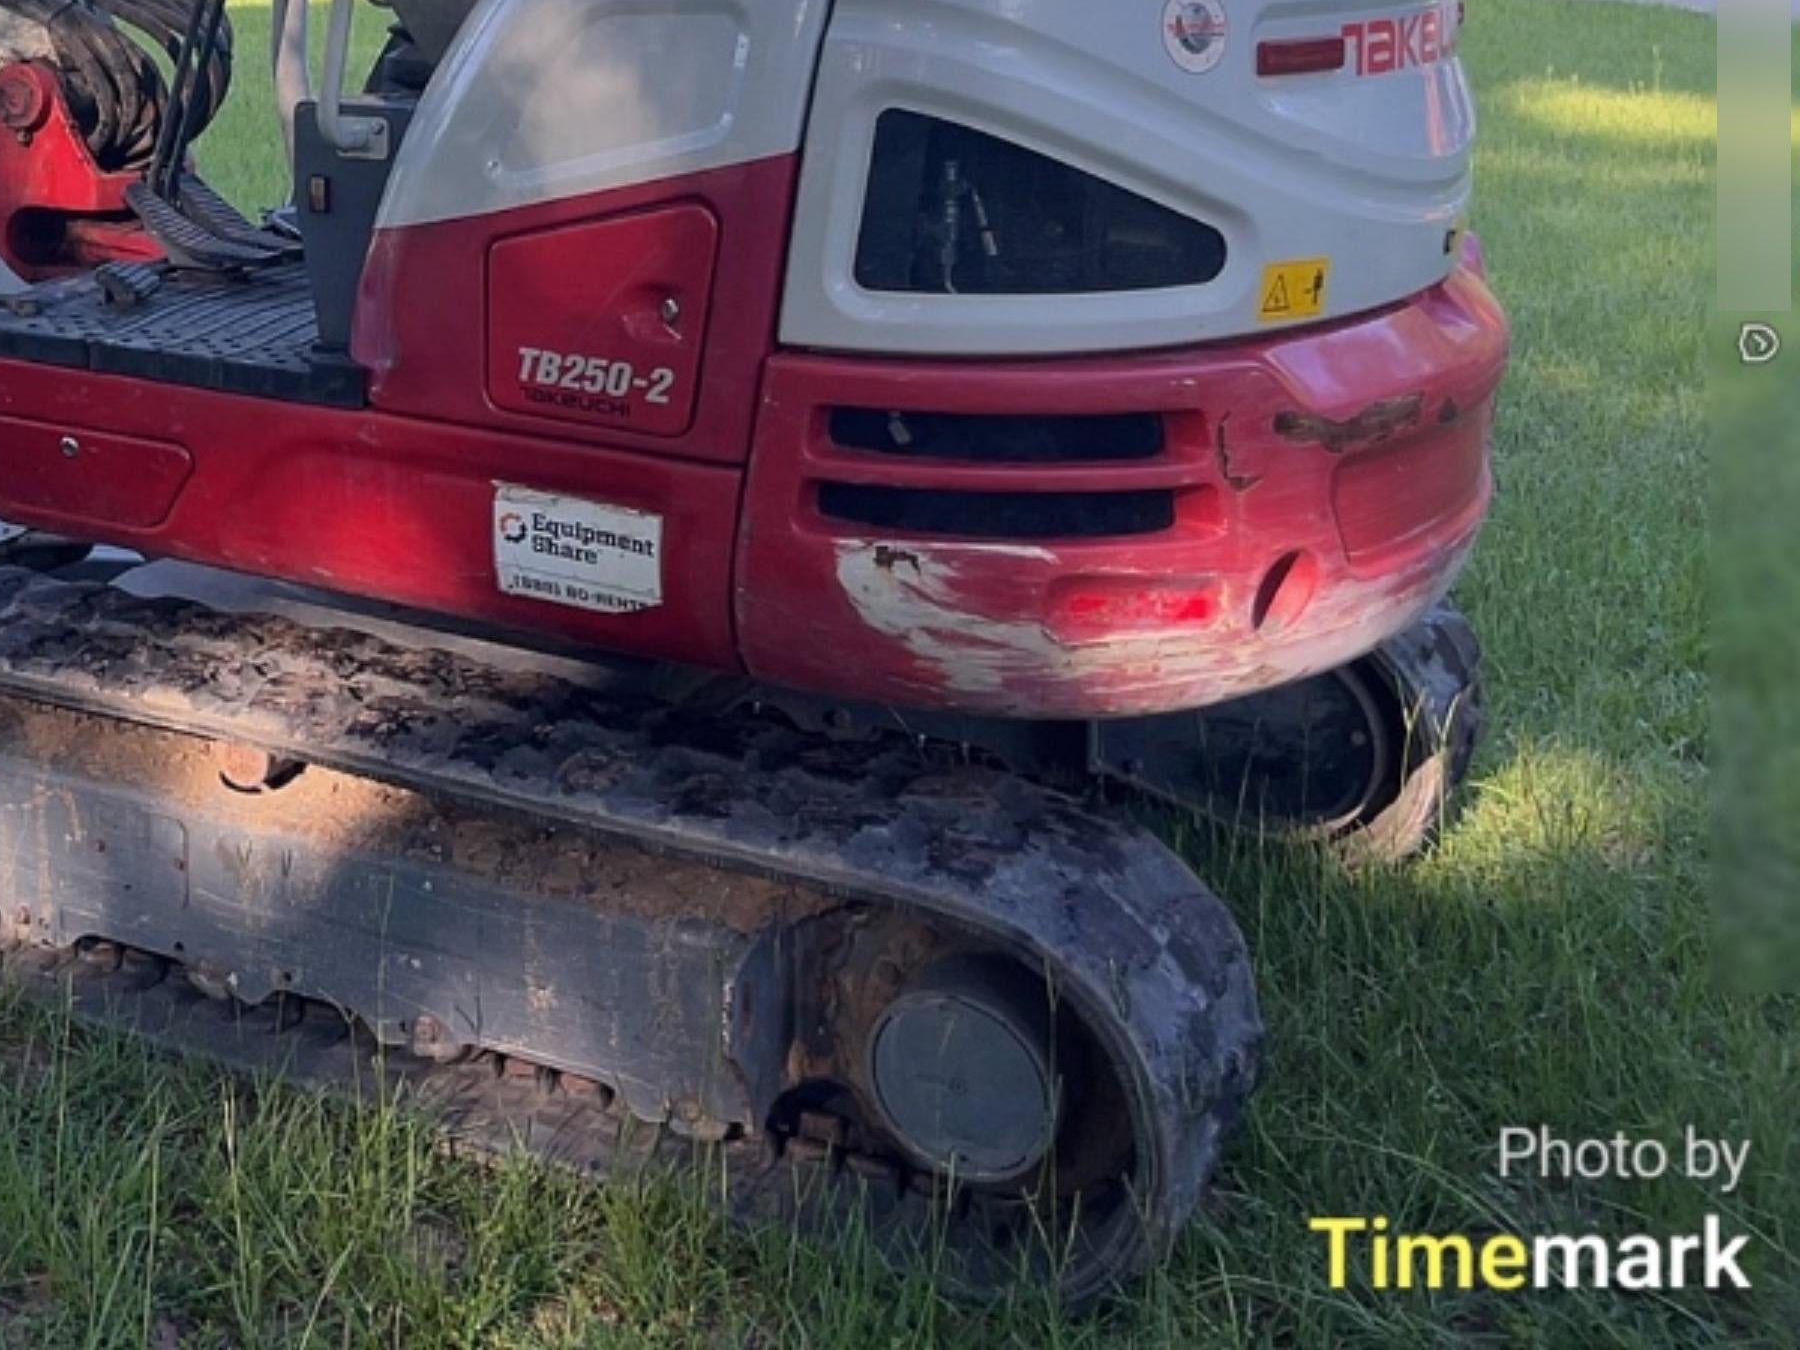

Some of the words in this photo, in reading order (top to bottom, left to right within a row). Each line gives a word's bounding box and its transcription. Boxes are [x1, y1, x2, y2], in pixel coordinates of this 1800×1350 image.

[518, 347, 674, 403] TB250-2
[531, 512, 656, 558] Equipment
[531, 534, 598, 564] Share
